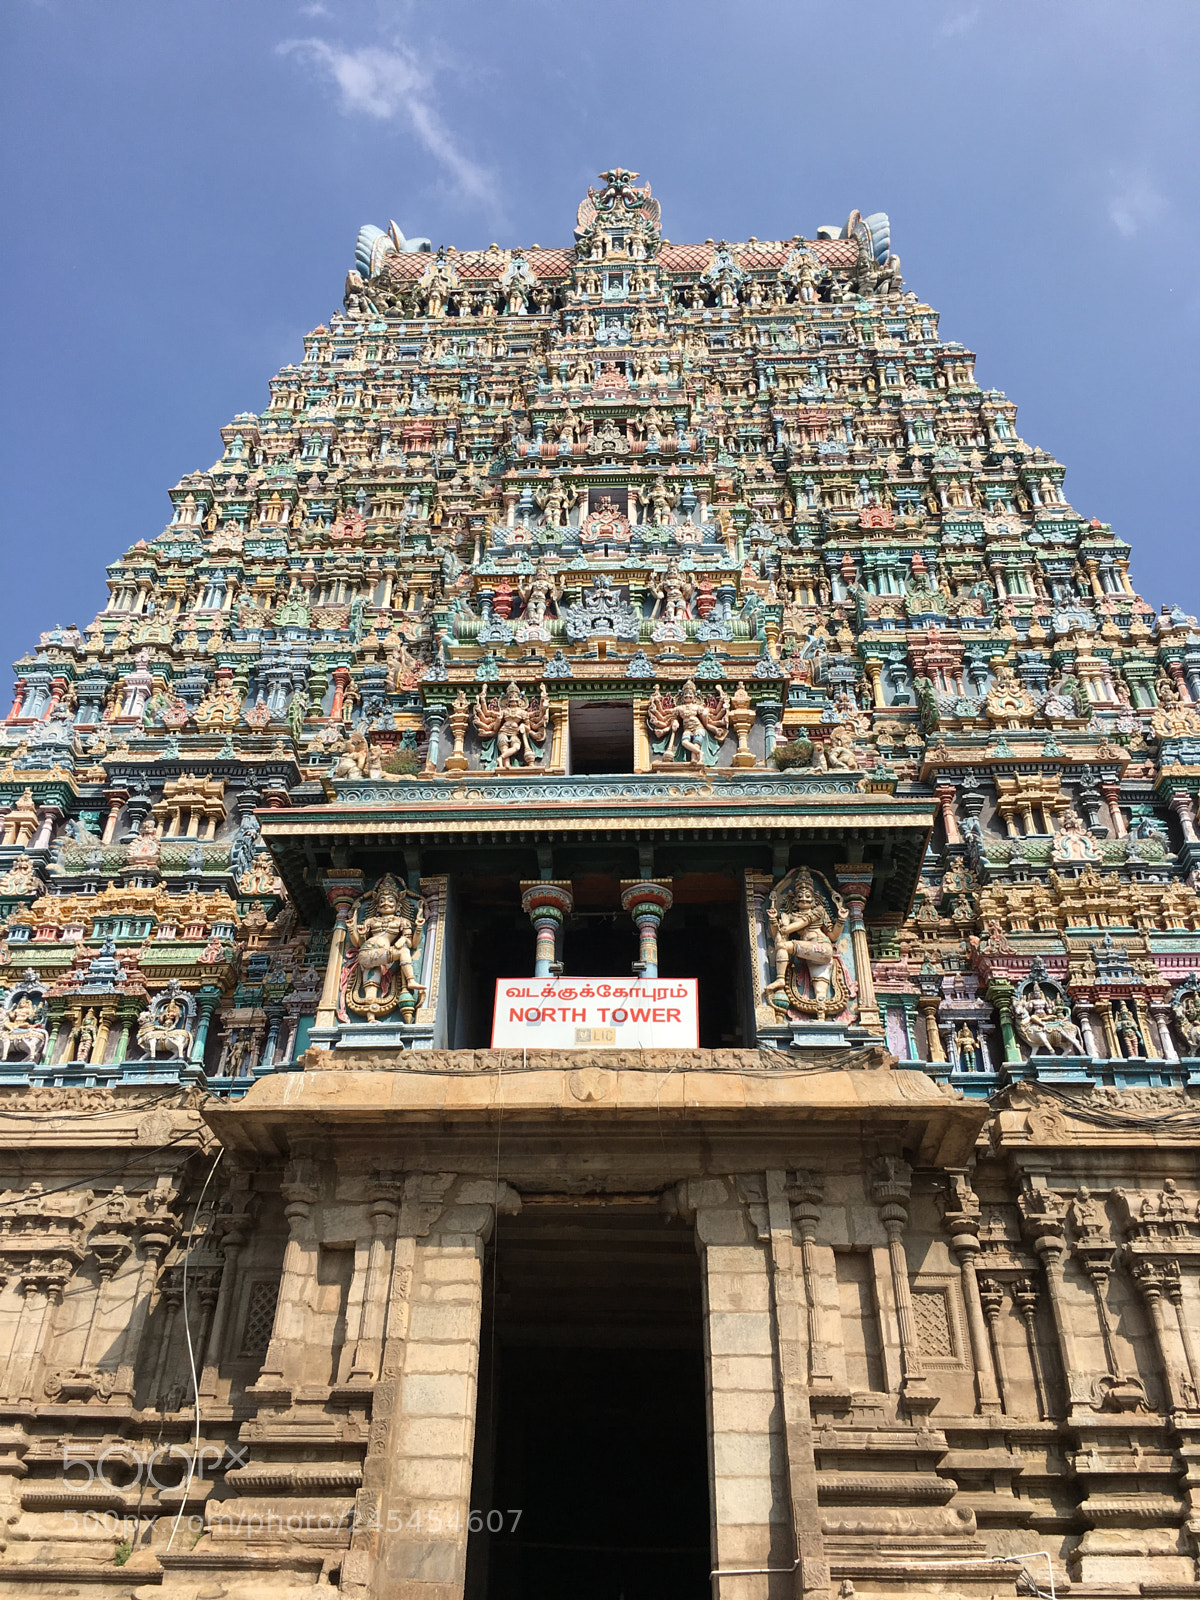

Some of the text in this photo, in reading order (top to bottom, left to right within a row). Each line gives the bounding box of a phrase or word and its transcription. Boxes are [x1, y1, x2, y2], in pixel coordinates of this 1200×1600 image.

[509, 1007, 681, 1023] NORTH TOWER
[593, 1030, 613, 1041] LIC
